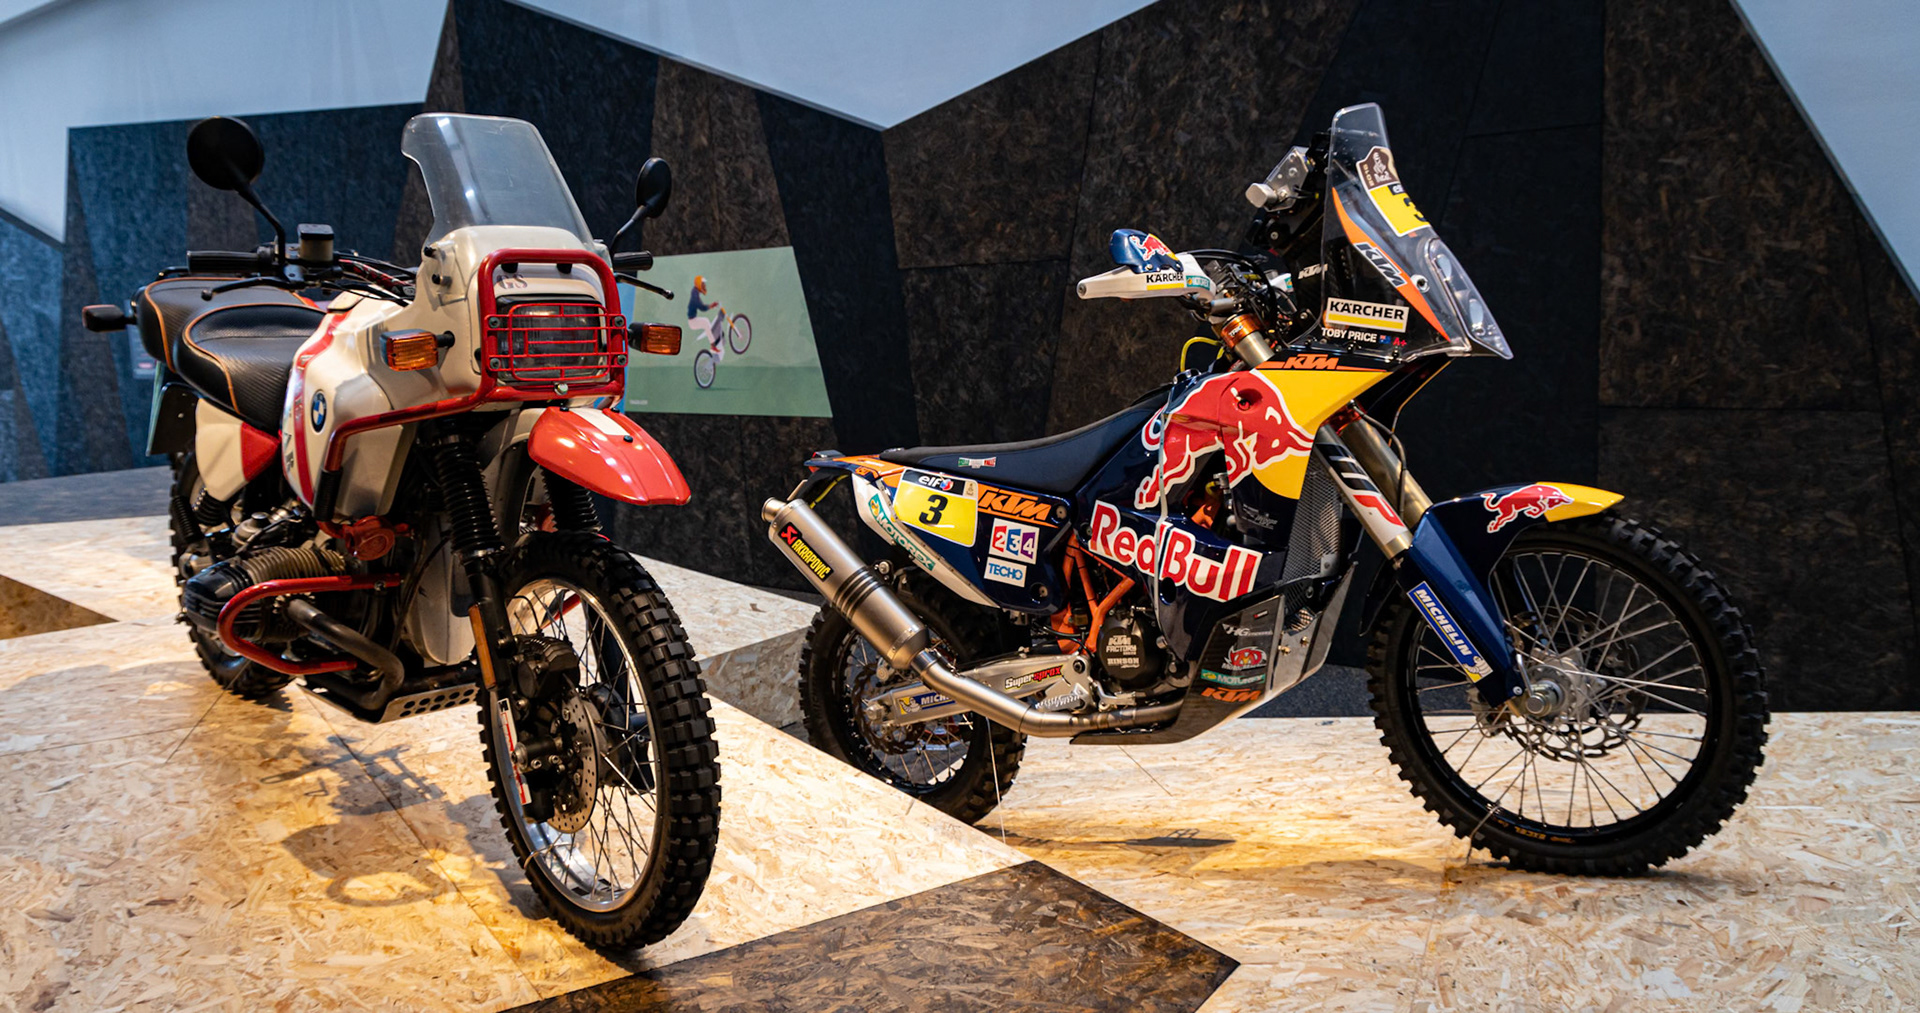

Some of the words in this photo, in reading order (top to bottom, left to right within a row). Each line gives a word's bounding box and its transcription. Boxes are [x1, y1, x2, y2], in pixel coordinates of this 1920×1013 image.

[1297, 263, 1329, 280] KTM
[1355, 243, 1406, 287] KTM
[1329, 300, 1404, 321] KÄRCHER
[1321, 327, 1347, 340] TOBY
[1347, 330, 1377, 343] PRICE
[1283, 353, 1340, 370] KTM
[918, 475, 943, 488] elf
[918, 494, 948, 525] 3
[978, 488, 1052, 521] KTM
[876, 512, 934, 569] MOTOREX
[1091, 503, 1167, 576] Red
[1161, 530, 1258, 601] Bull
[988, 562, 1023, 581] TECHO
[1416, 588, 1473, 656] MICHELIN
[1106, 645, 1137, 653] FACTORY
[1108, 635, 1131, 646] KTM
[1004, 665, 1063, 689] Supersprox
[1201, 687, 1262, 703] KTM
